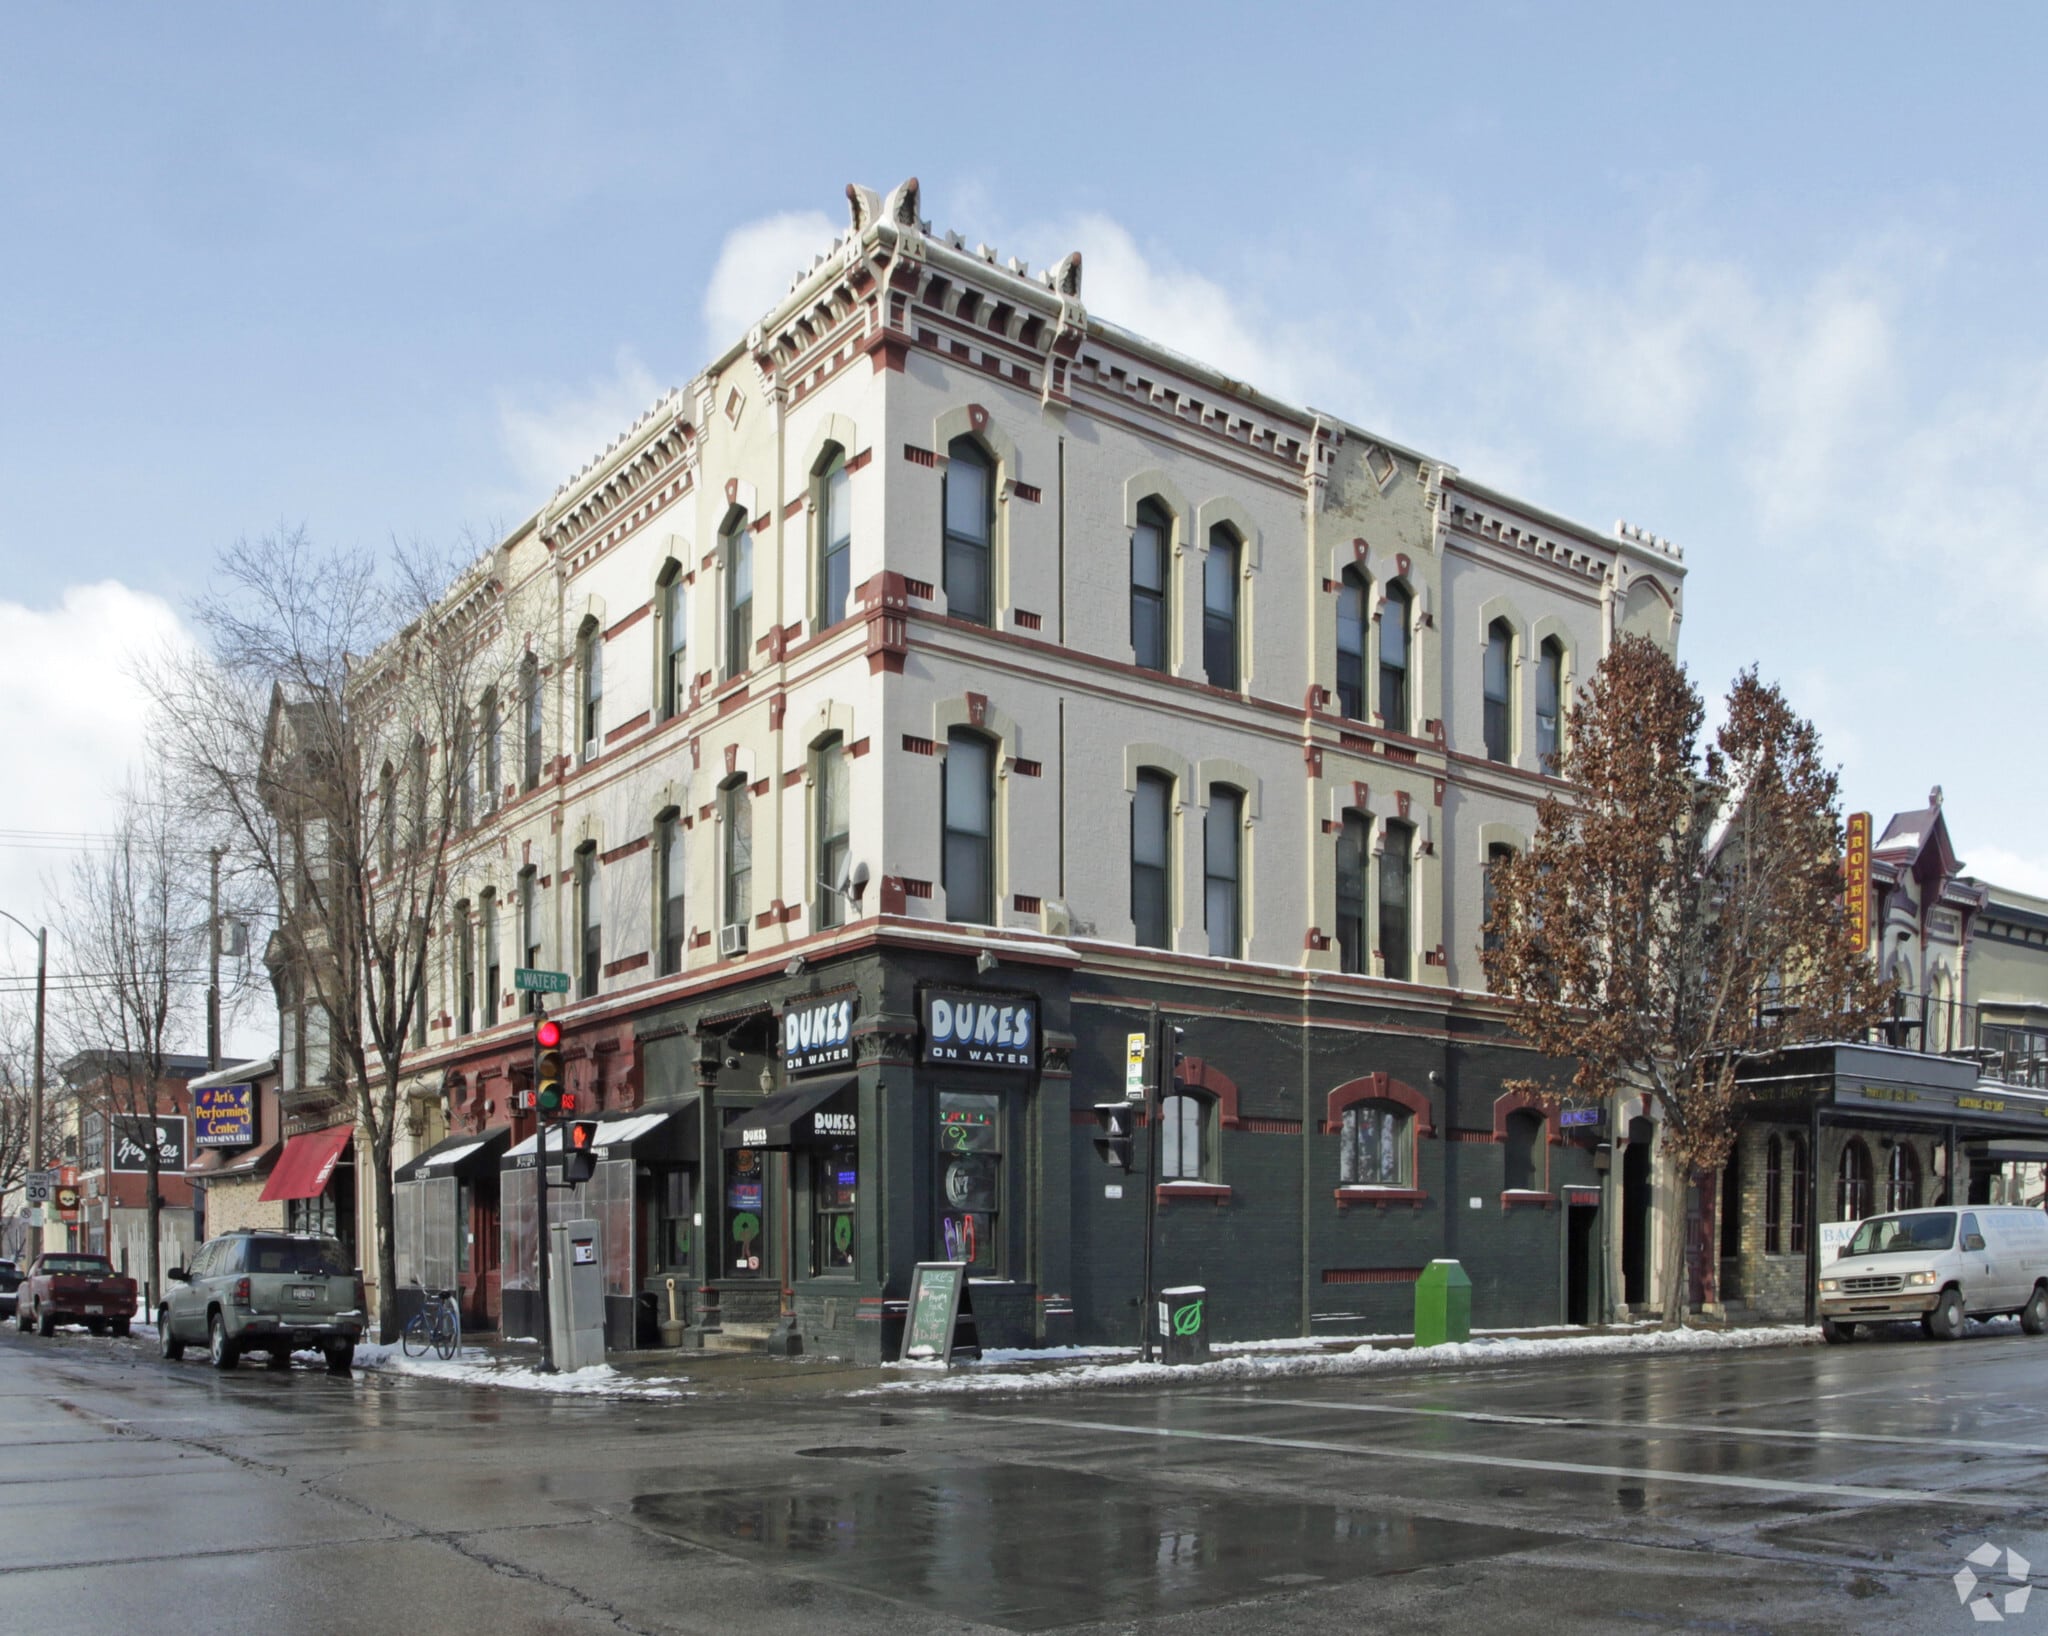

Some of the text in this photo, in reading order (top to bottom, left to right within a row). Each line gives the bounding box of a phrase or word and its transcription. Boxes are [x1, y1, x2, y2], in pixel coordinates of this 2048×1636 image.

[523, 972, 558, 989] WATER
[786, 1000, 850, 1054] DUKES
[932, 999, 1030, 1050] DUKES
[787, 1048, 849, 1069] ON WATER
[932, 1047, 1028, 1064] ON WATER
[196, 1104, 251, 1125] Performing
[814, 1112, 856, 1130] DUKES
[207, 1120, 240, 1135] Center
[743, 1128, 767, 1142] DUKES
[29, 1187, 47, 1198] 30
